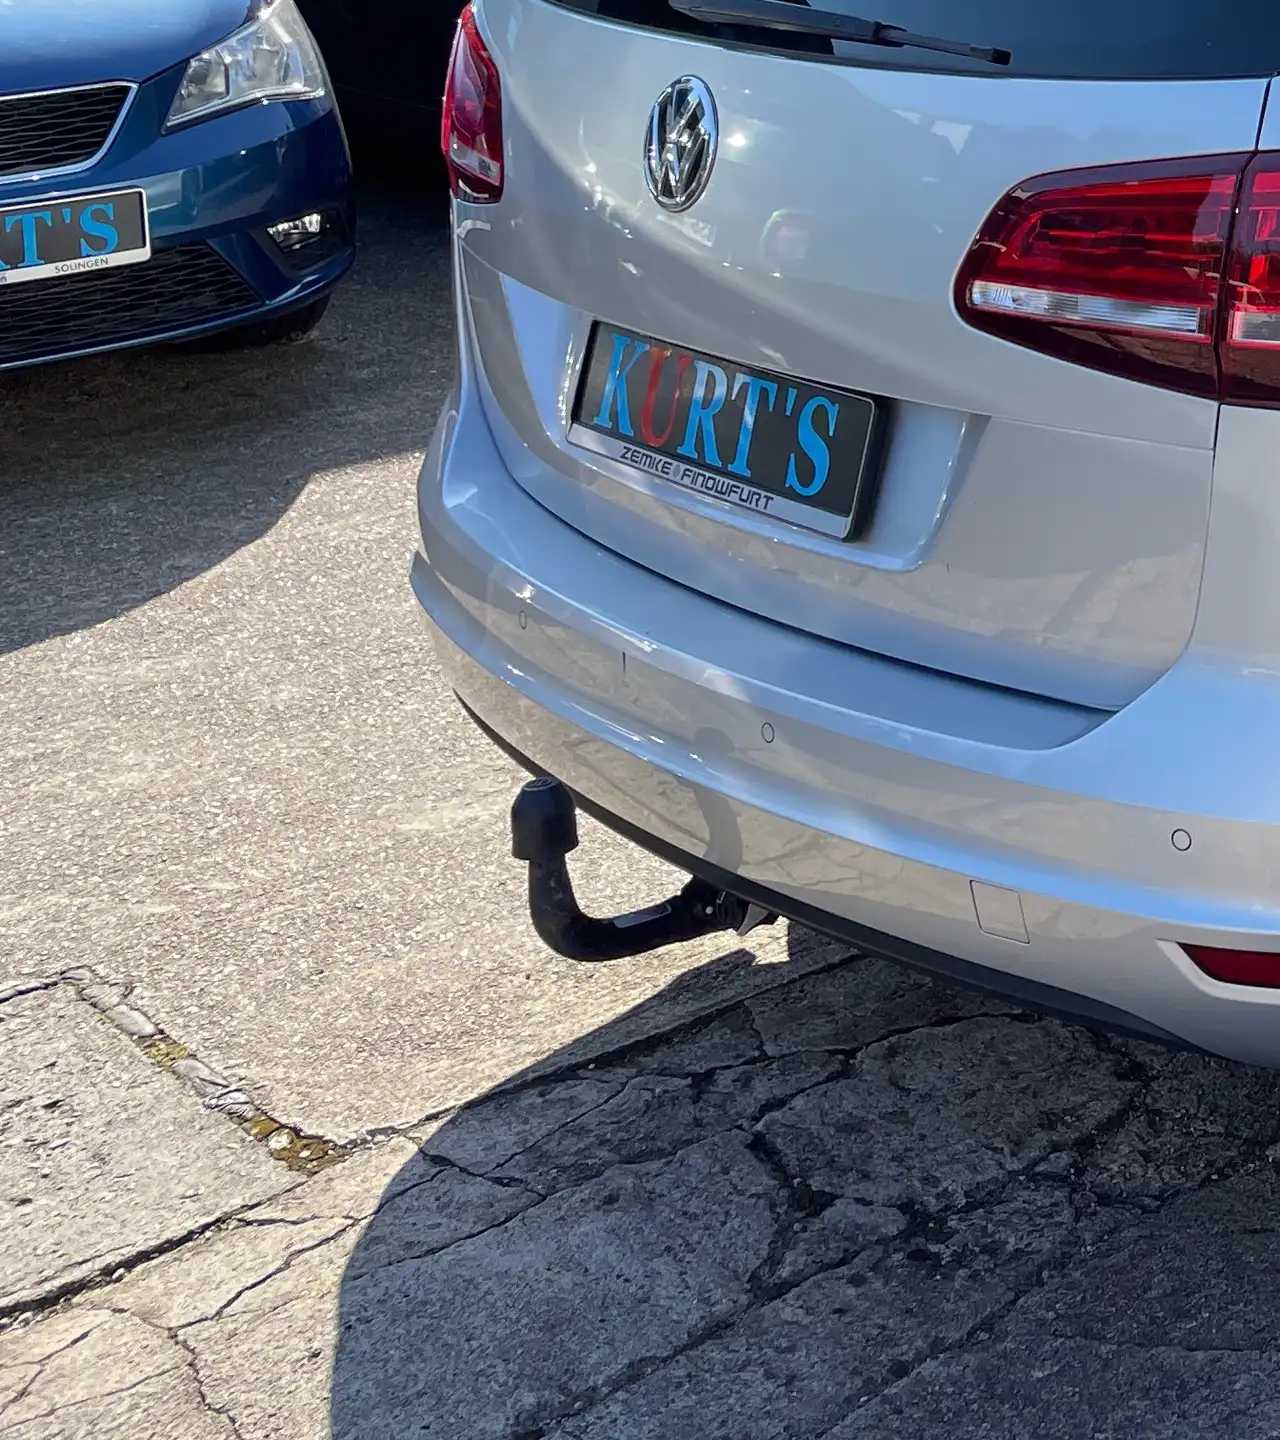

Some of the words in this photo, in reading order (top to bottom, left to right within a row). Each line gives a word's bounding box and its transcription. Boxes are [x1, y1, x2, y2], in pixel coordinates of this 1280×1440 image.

[54, 257, 109, 274] SOLINGEN
[592, 332, 840, 497] KURT'S
[620, 446, 673, 476] ZEMKE
[679, 467, 774, 510] FINOWFURT
